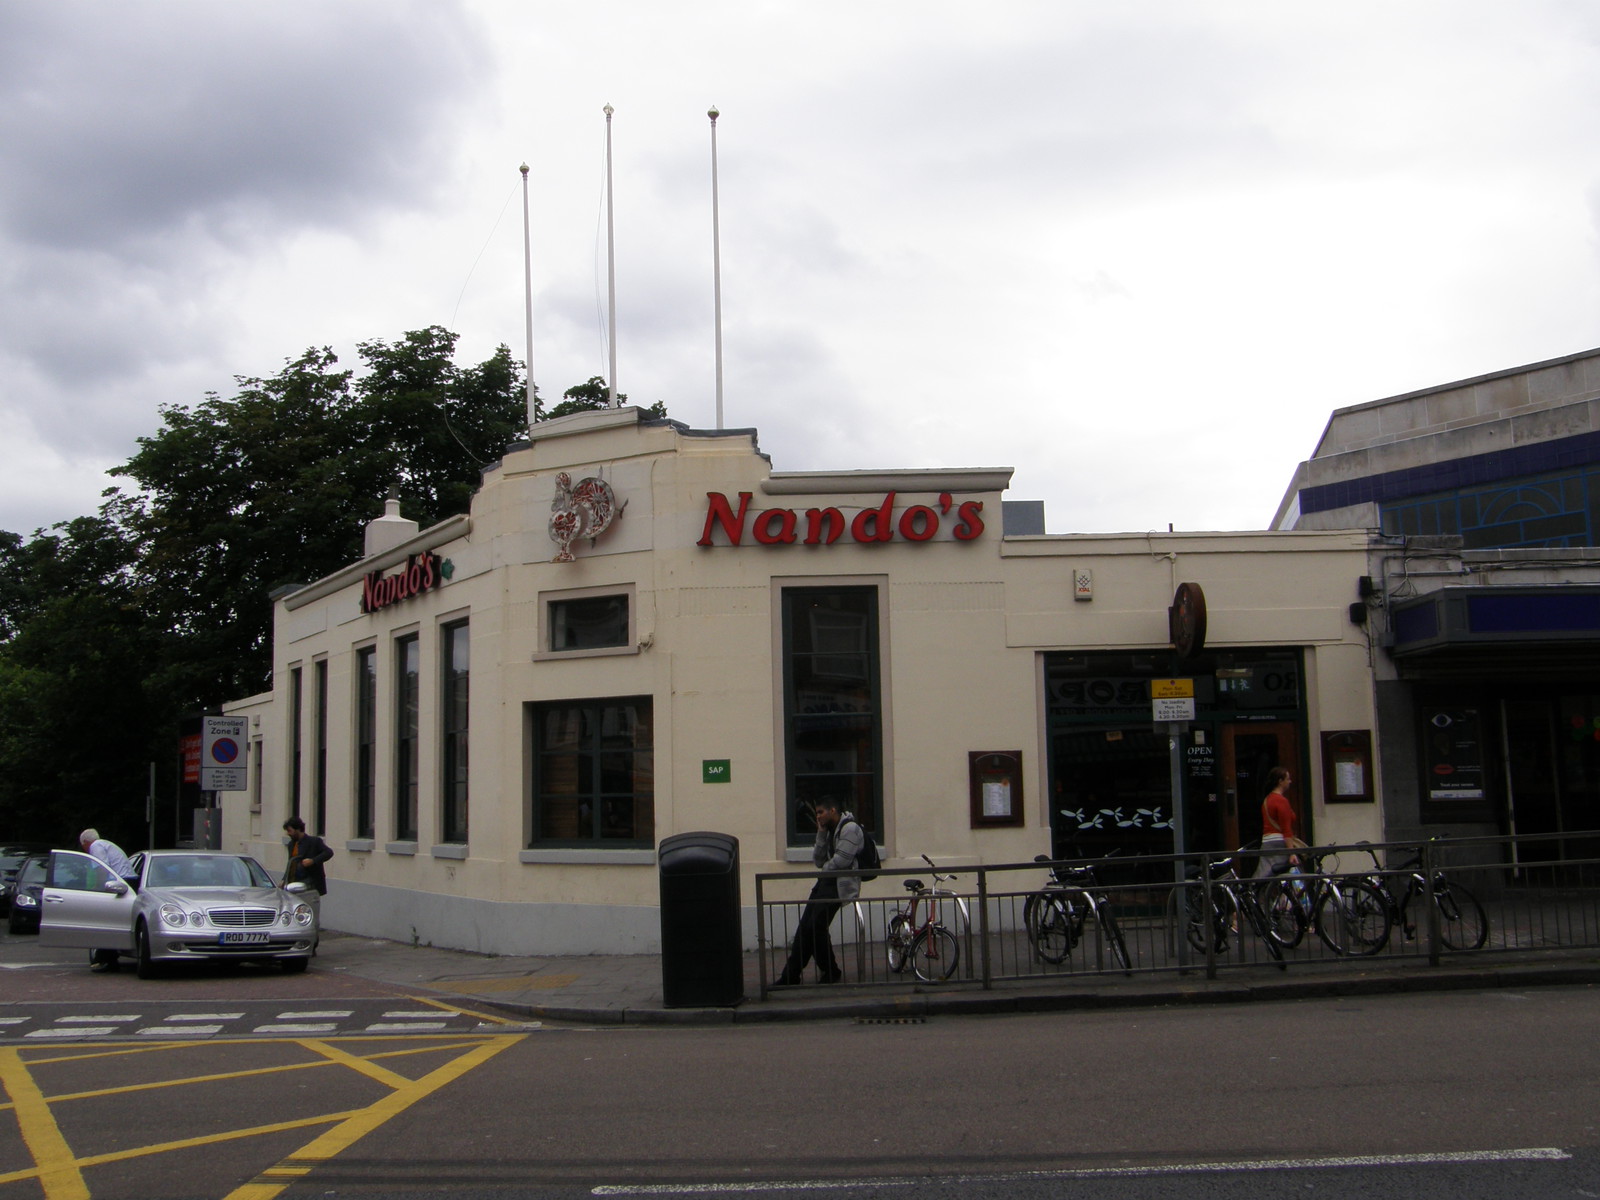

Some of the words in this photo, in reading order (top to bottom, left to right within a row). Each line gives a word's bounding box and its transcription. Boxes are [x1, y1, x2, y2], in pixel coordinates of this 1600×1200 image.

[696, 490, 985, 546] Nando's
[361, 551, 441, 614] Nando's
[211, 727, 231, 735] Zone
[1187, 747, 1212, 755] OPEN
[708, 766, 724, 774] SAP
[245, 933, 268, 942] 777X
